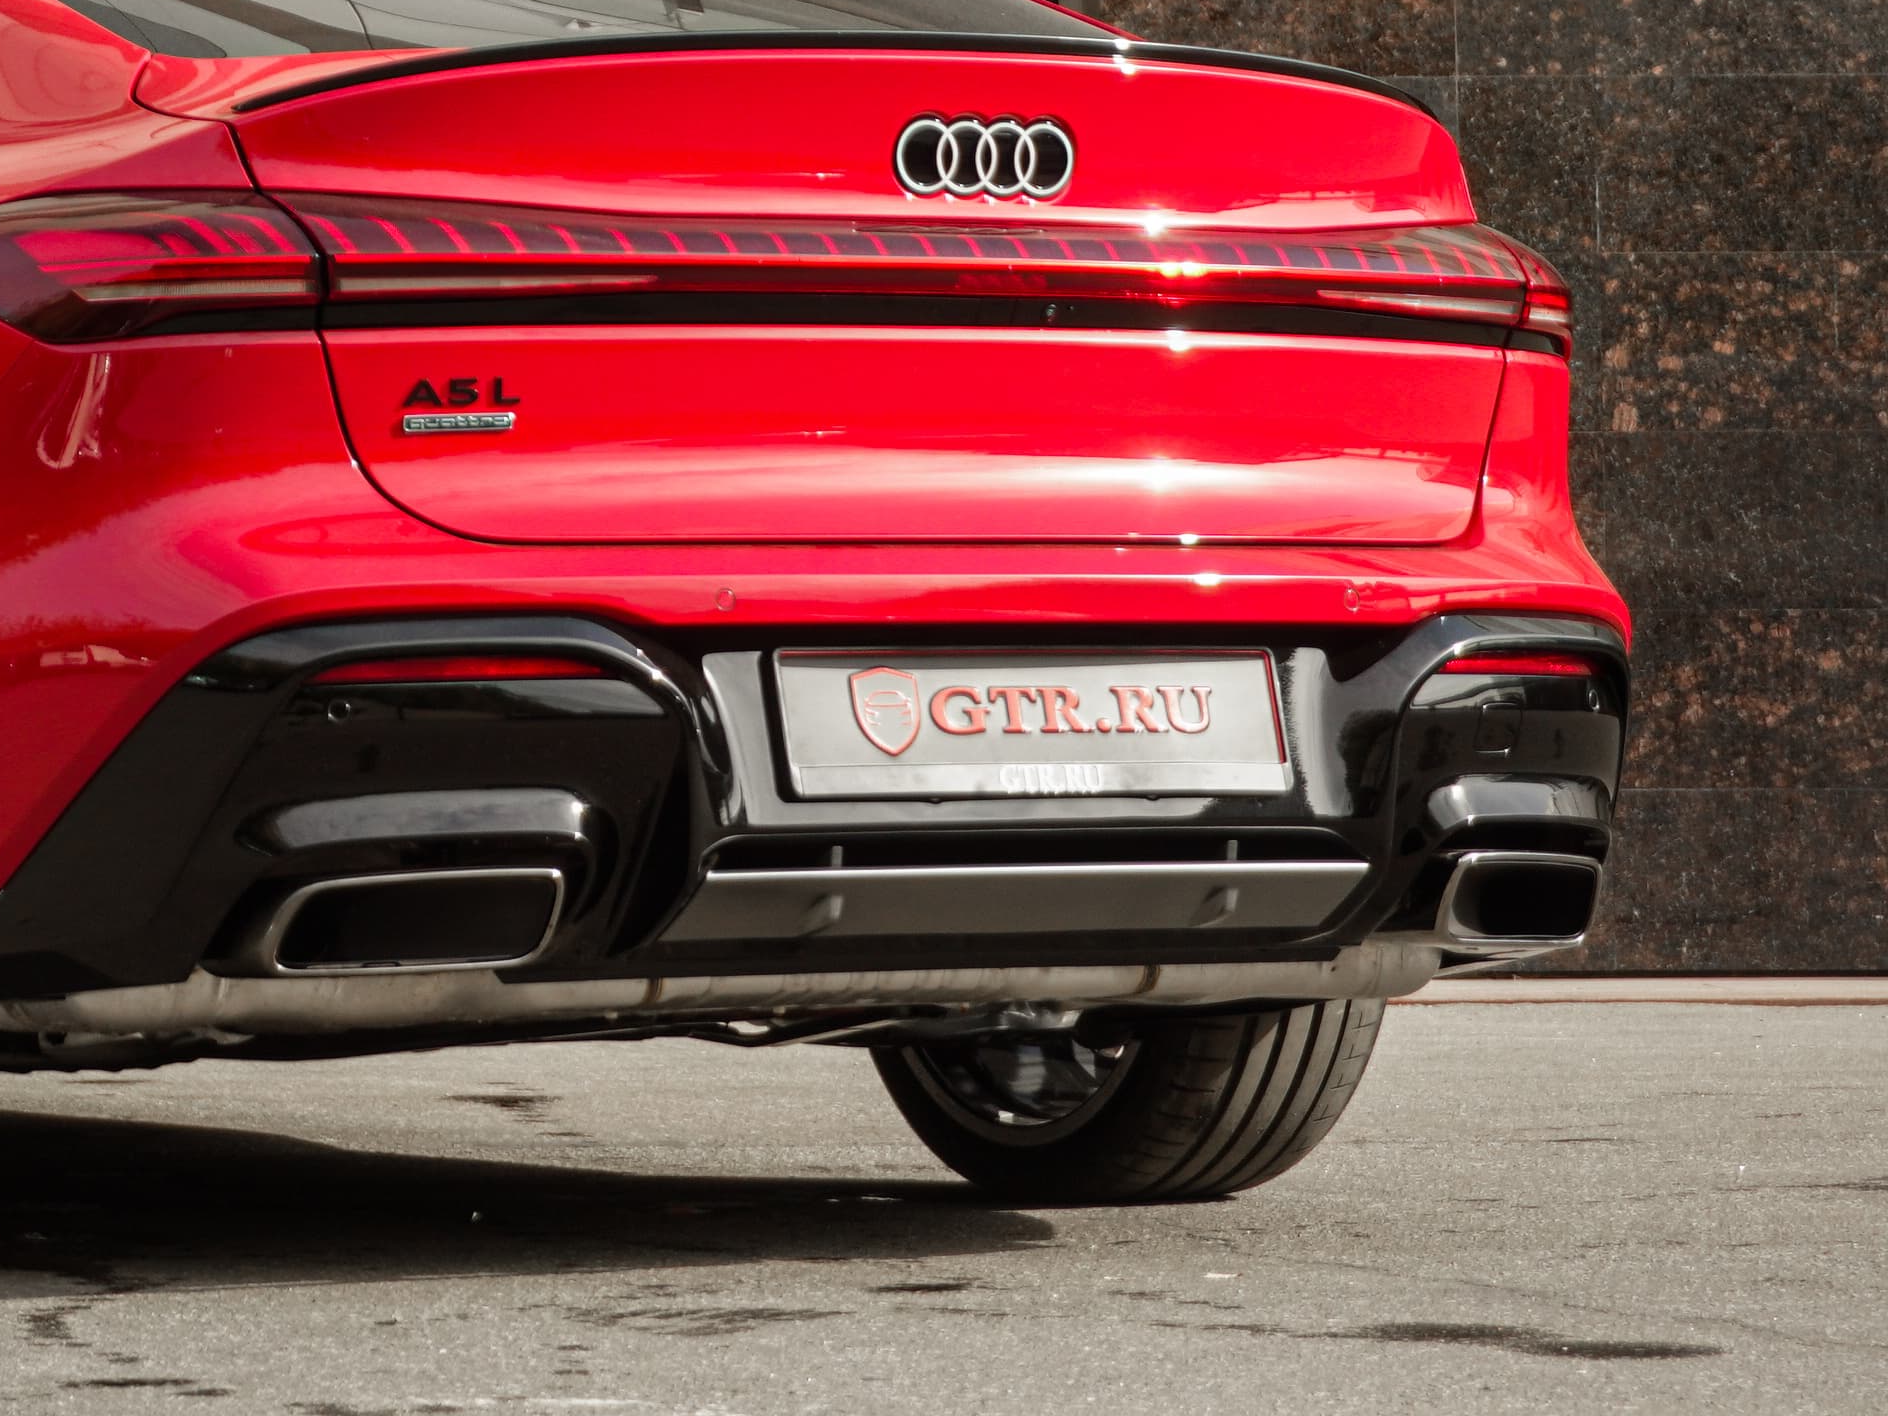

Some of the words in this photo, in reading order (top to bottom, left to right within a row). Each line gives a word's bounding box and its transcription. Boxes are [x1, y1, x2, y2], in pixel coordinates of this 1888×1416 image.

[403, 377, 479, 406] A5
[492, 376, 521, 404] L
[409, 415, 509, 430] quattro
[929, 685, 1212, 736] GTR.RU
